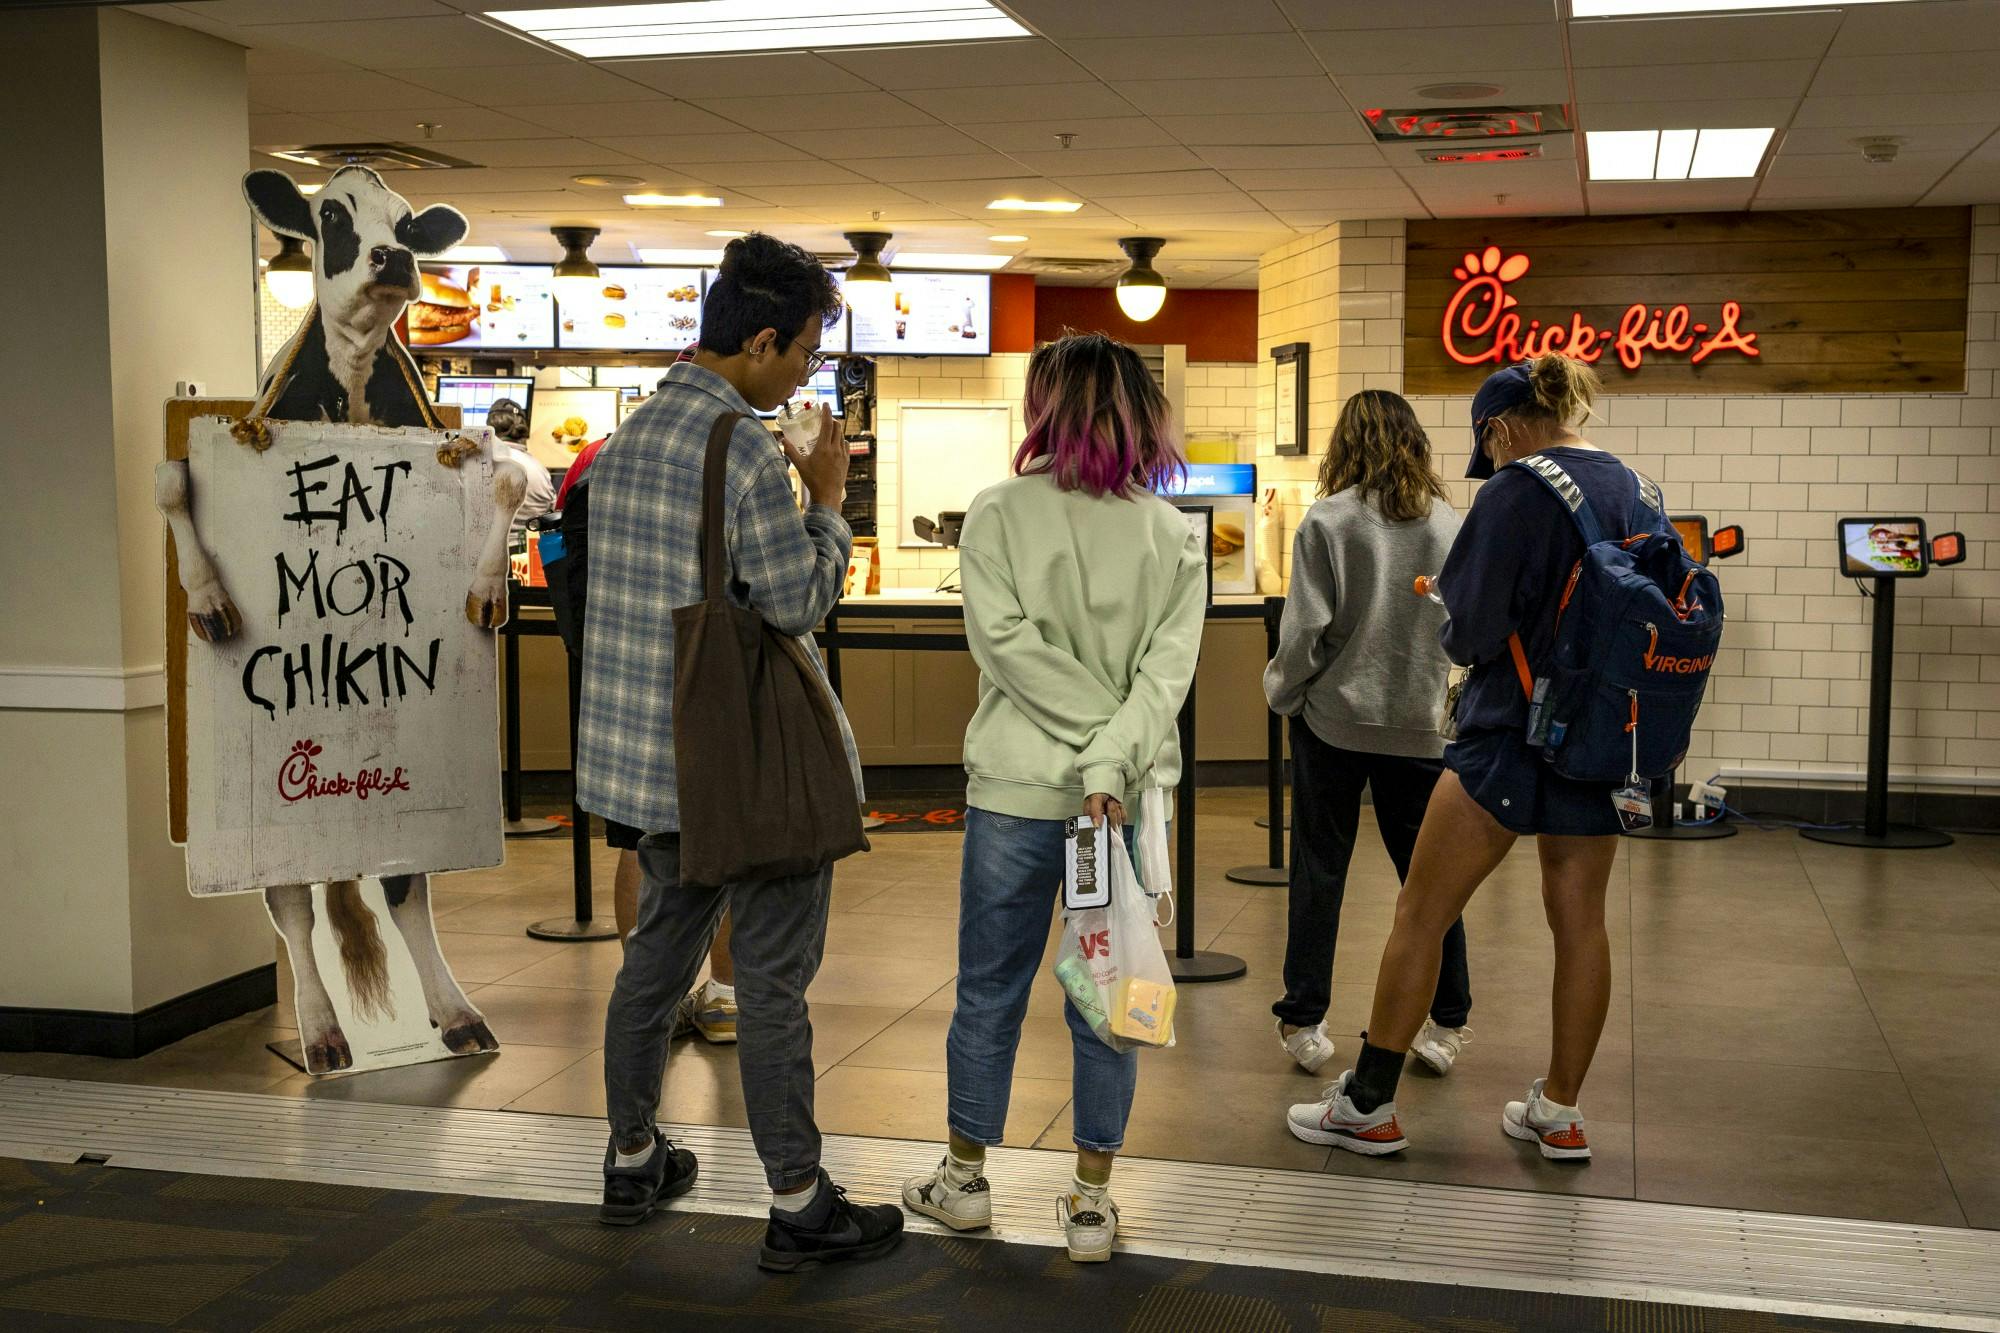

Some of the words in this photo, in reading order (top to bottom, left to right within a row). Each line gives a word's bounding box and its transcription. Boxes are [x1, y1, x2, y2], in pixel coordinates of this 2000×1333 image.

[1443, 274, 1760, 370] Chick-fil-A
[283, 455, 412, 546] EAT
[274, 548, 414, 637] MOR
[242, 633, 440, 721] CHIKIN
[278, 751, 410, 801] Chick-fil-A
